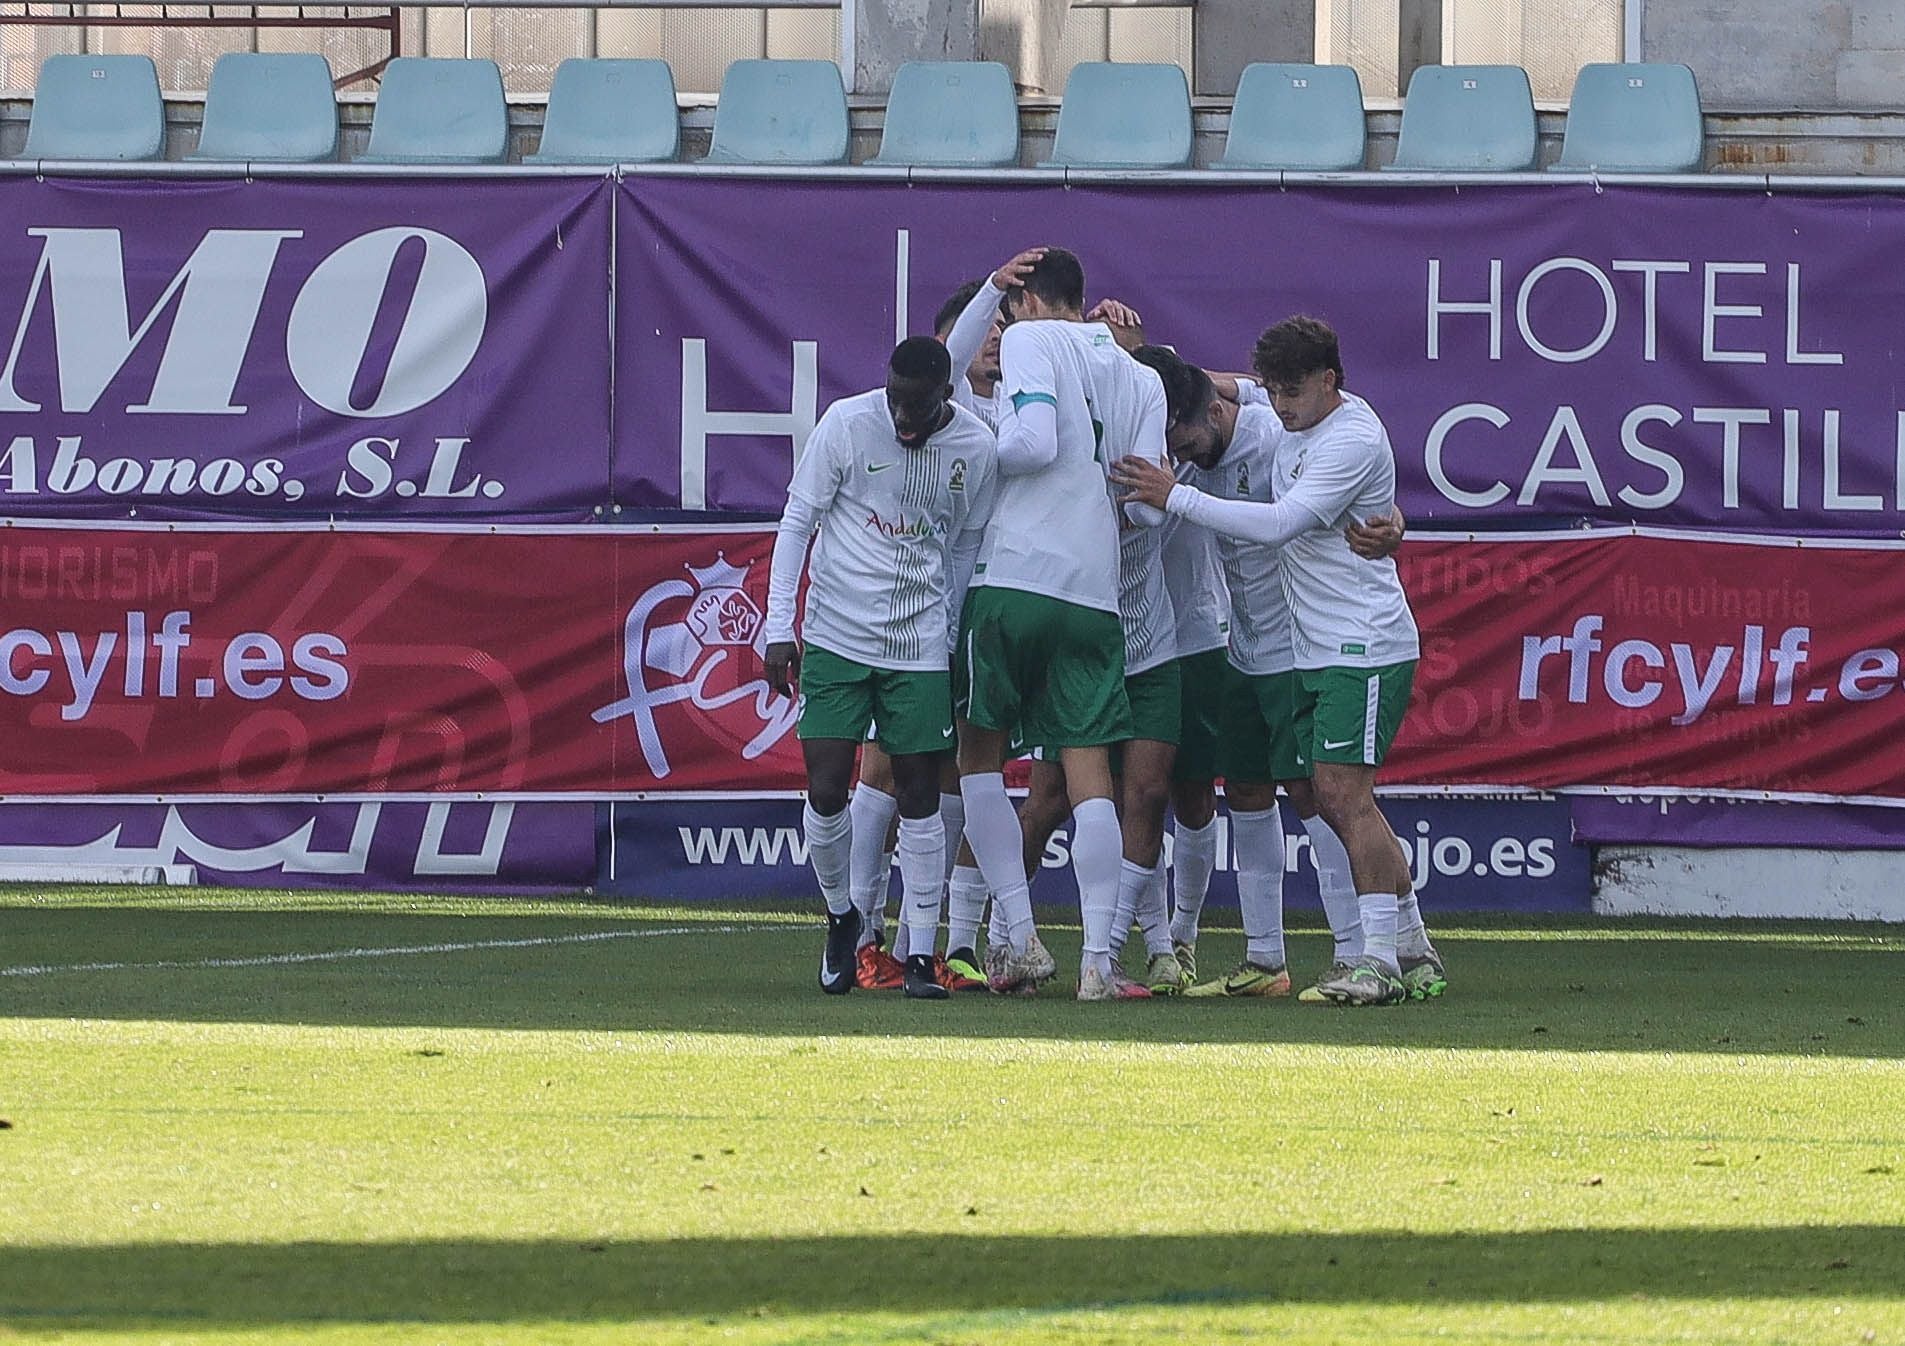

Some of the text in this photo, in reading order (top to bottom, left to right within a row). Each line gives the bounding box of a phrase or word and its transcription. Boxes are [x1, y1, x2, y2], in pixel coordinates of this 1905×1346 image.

[1427, 257, 1844, 364] HOTEL
[336, 437, 505, 499] S.L.
[1424, 403, 1905, 511] CASTIL
[1518, 615, 1905, 726] rfcylf.e
